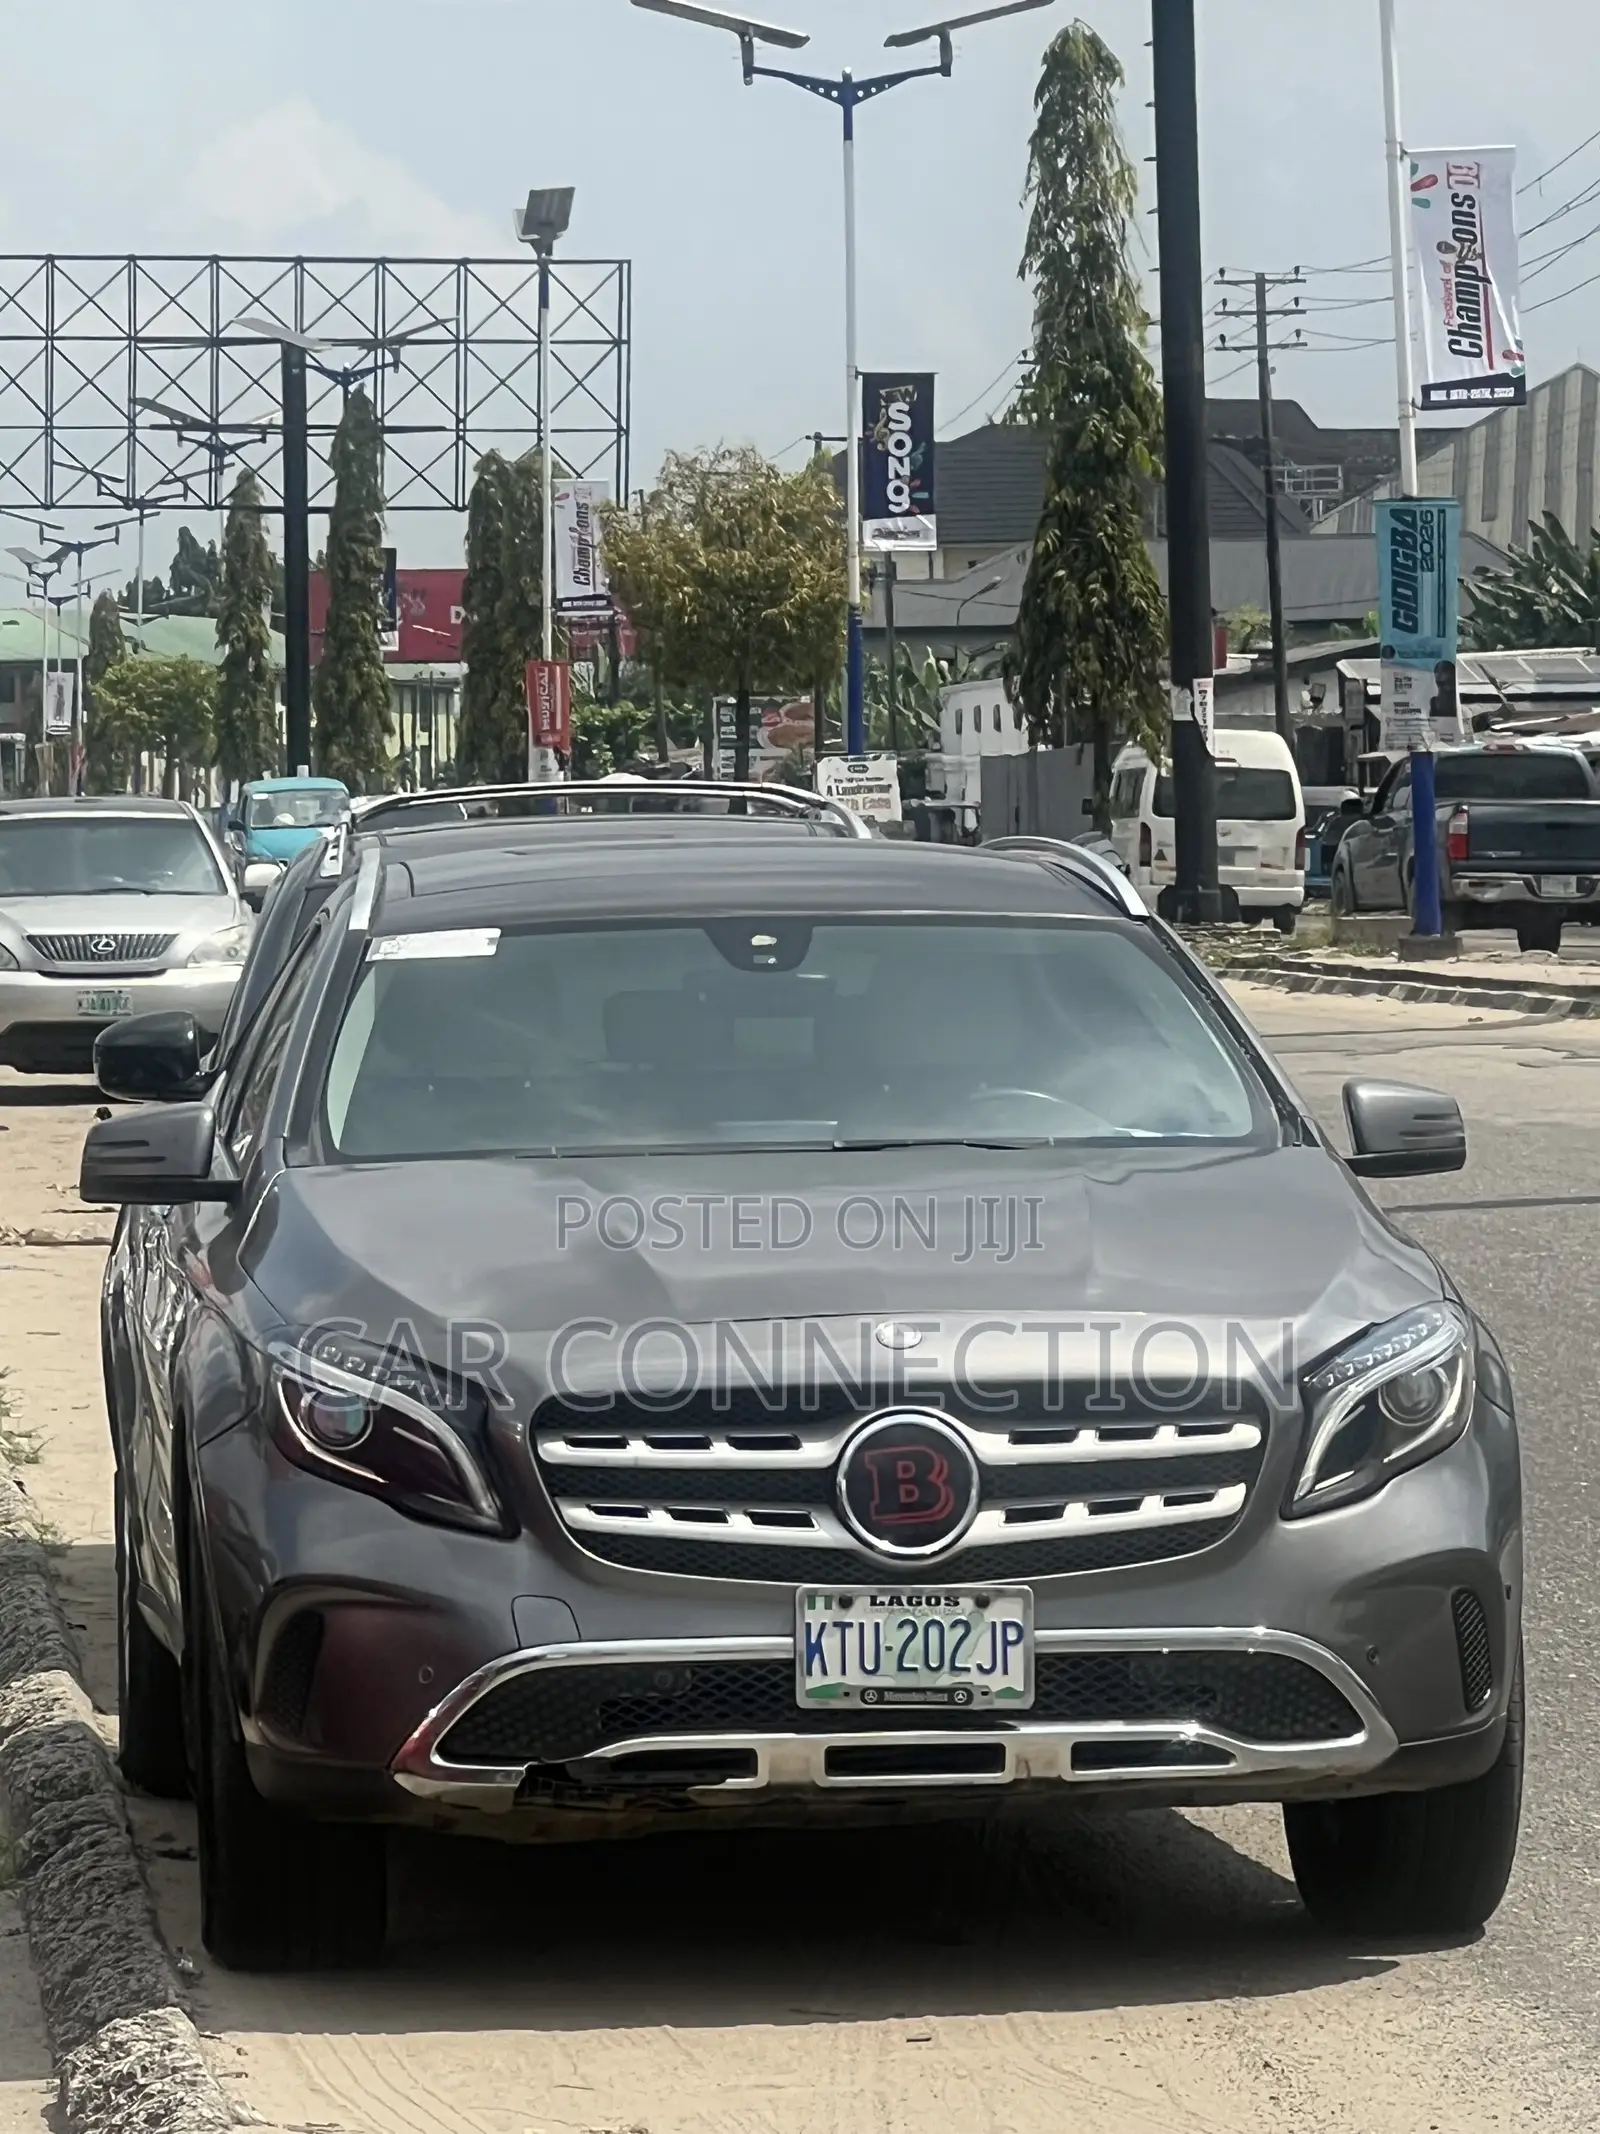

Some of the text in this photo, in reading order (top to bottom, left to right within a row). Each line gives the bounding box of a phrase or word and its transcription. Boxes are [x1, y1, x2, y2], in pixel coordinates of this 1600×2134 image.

[1389, 508, 1419, 634] GIDIGBA
[869, 1595, 960, 1607] LAGOS
[805, 1617, 1024, 1677] KTU-202JP
